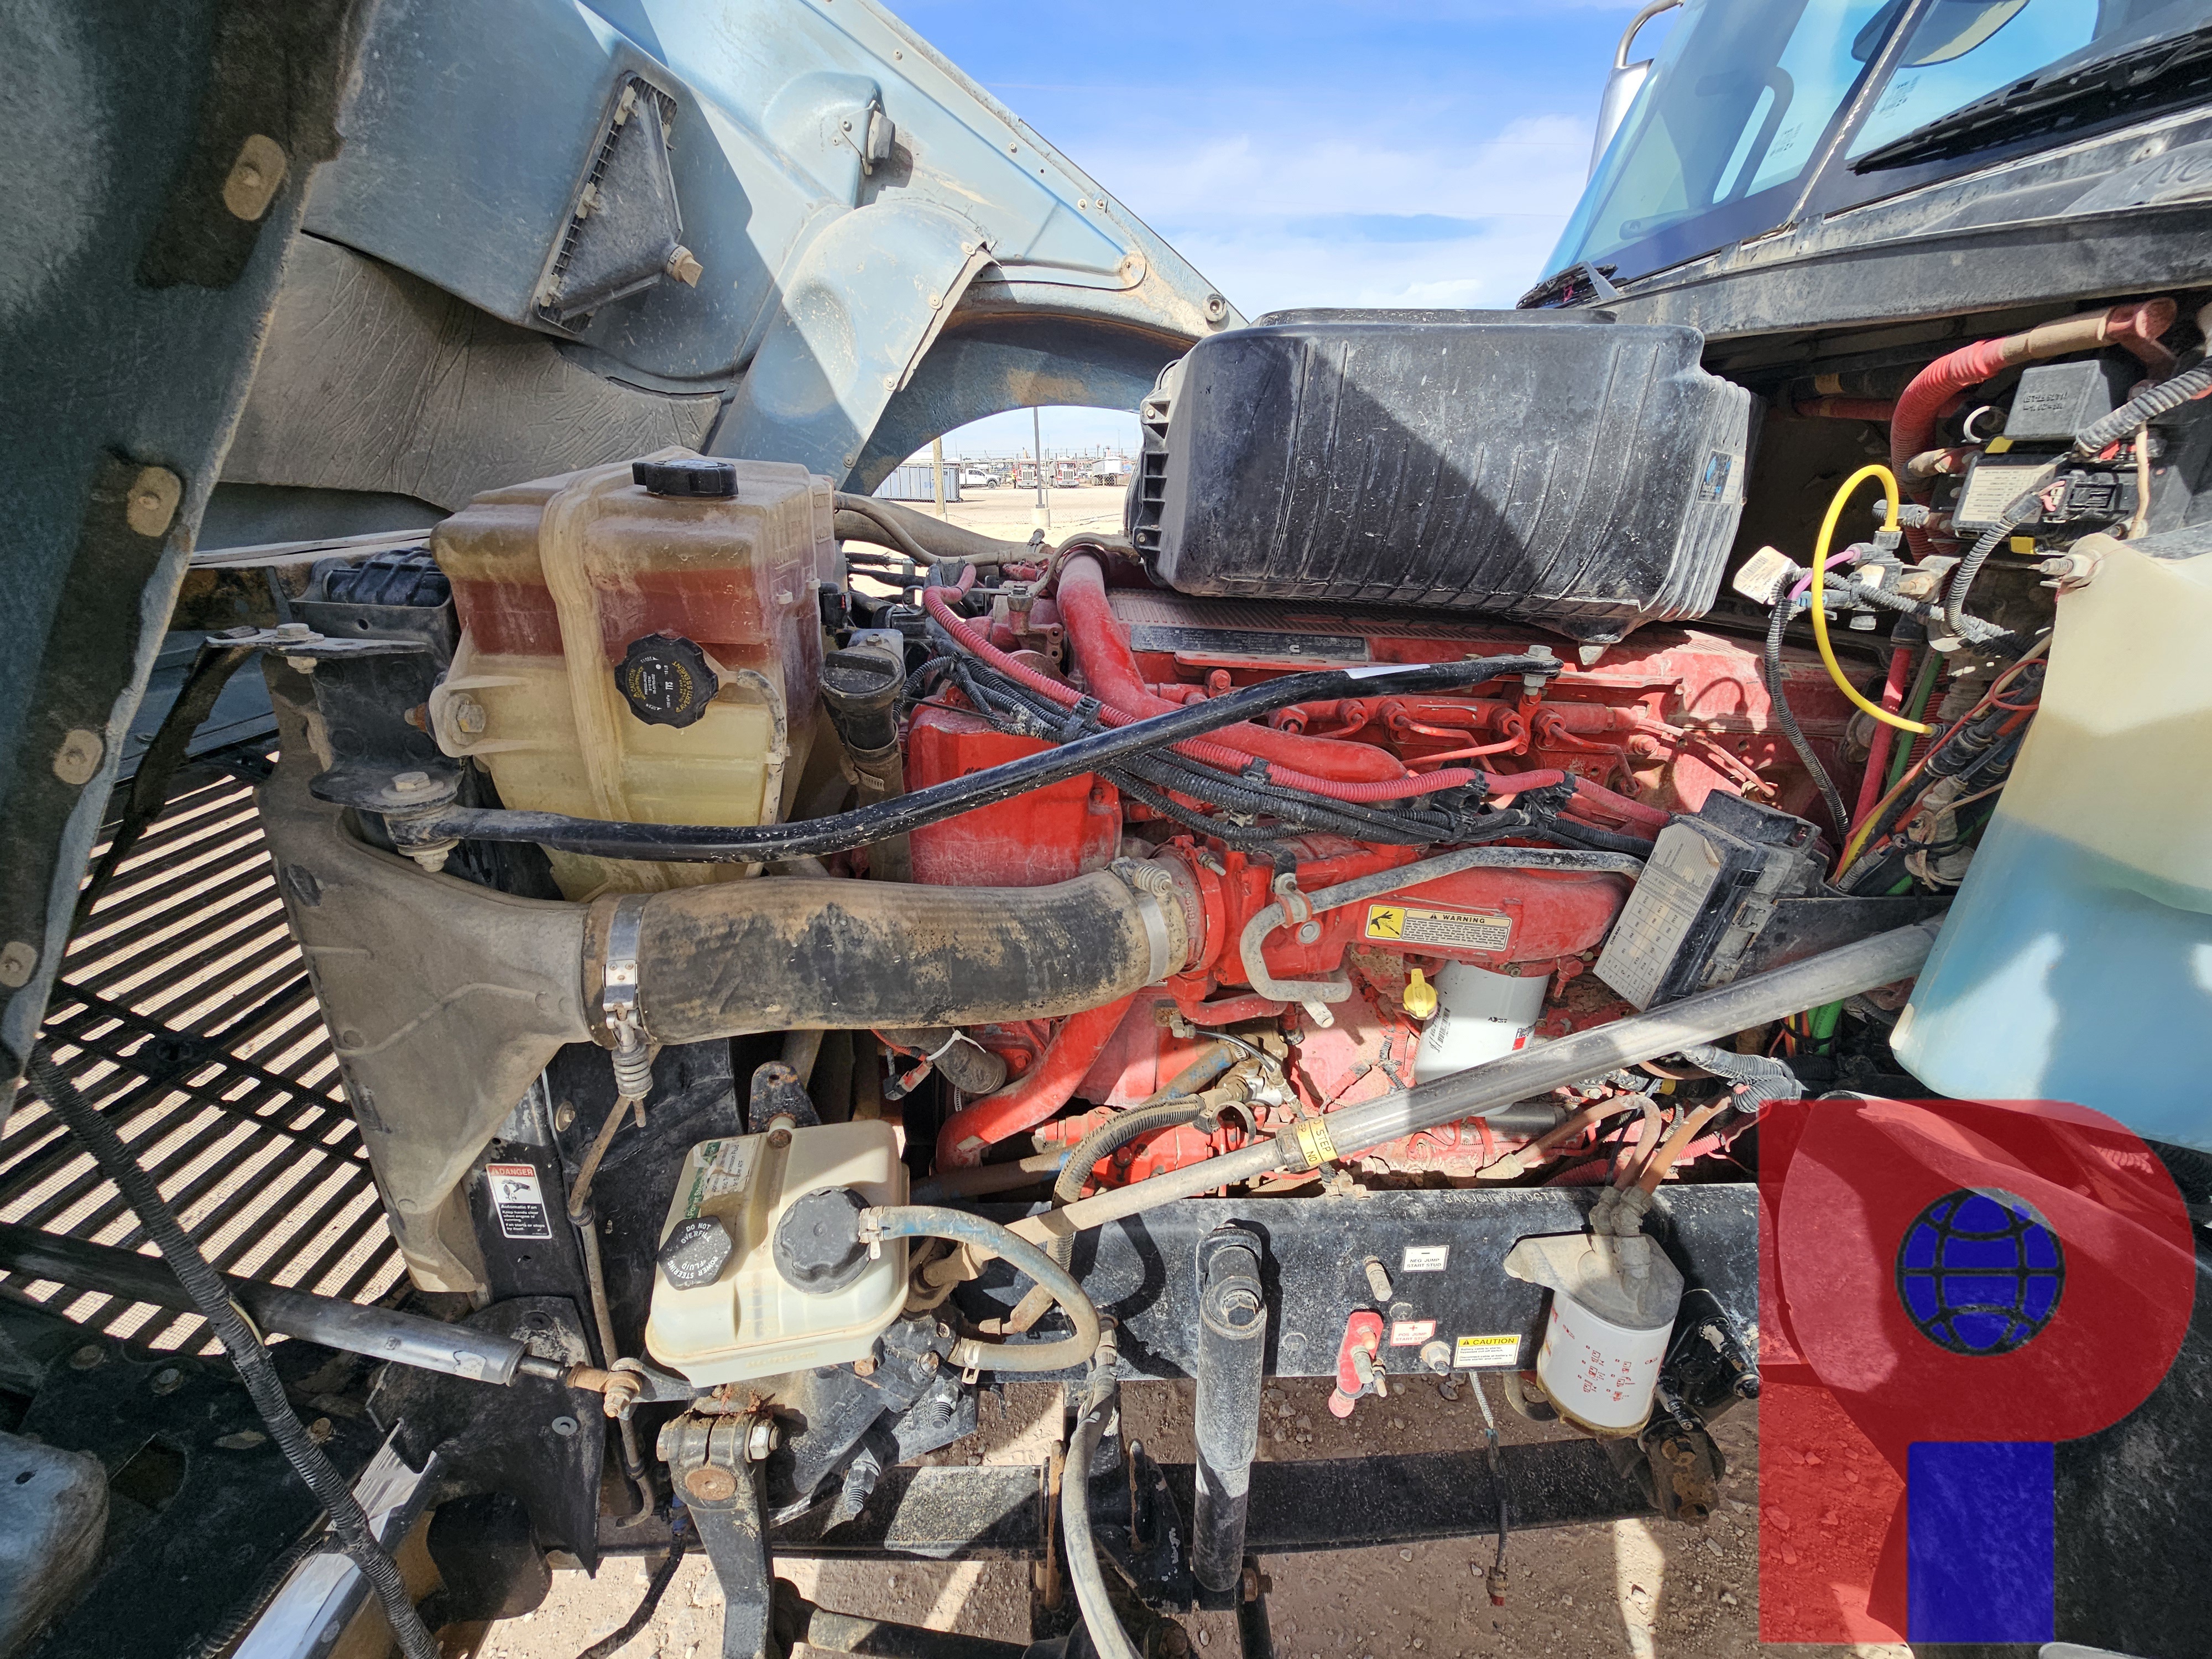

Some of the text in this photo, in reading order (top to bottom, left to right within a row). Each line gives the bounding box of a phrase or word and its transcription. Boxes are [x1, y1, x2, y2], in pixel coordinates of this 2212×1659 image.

[665, 681, 674, 690] TVS
[672, 660, 693, 709] AVERTISSEMENT
[1443, 915, 1485, 924] WARNING
[1316, 1129, 1331, 1152] STEP
[731, 1143, 739, 1155] Fluid
[1306, 1151, 1317, 1162] NO
[686, 1223, 695, 1232] DO
[681, 1230, 712, 1244] OVERFILL
[667, 1256, 718, 1279] POWER STEERING
[681, 1260, 705, 1270] FLUID
